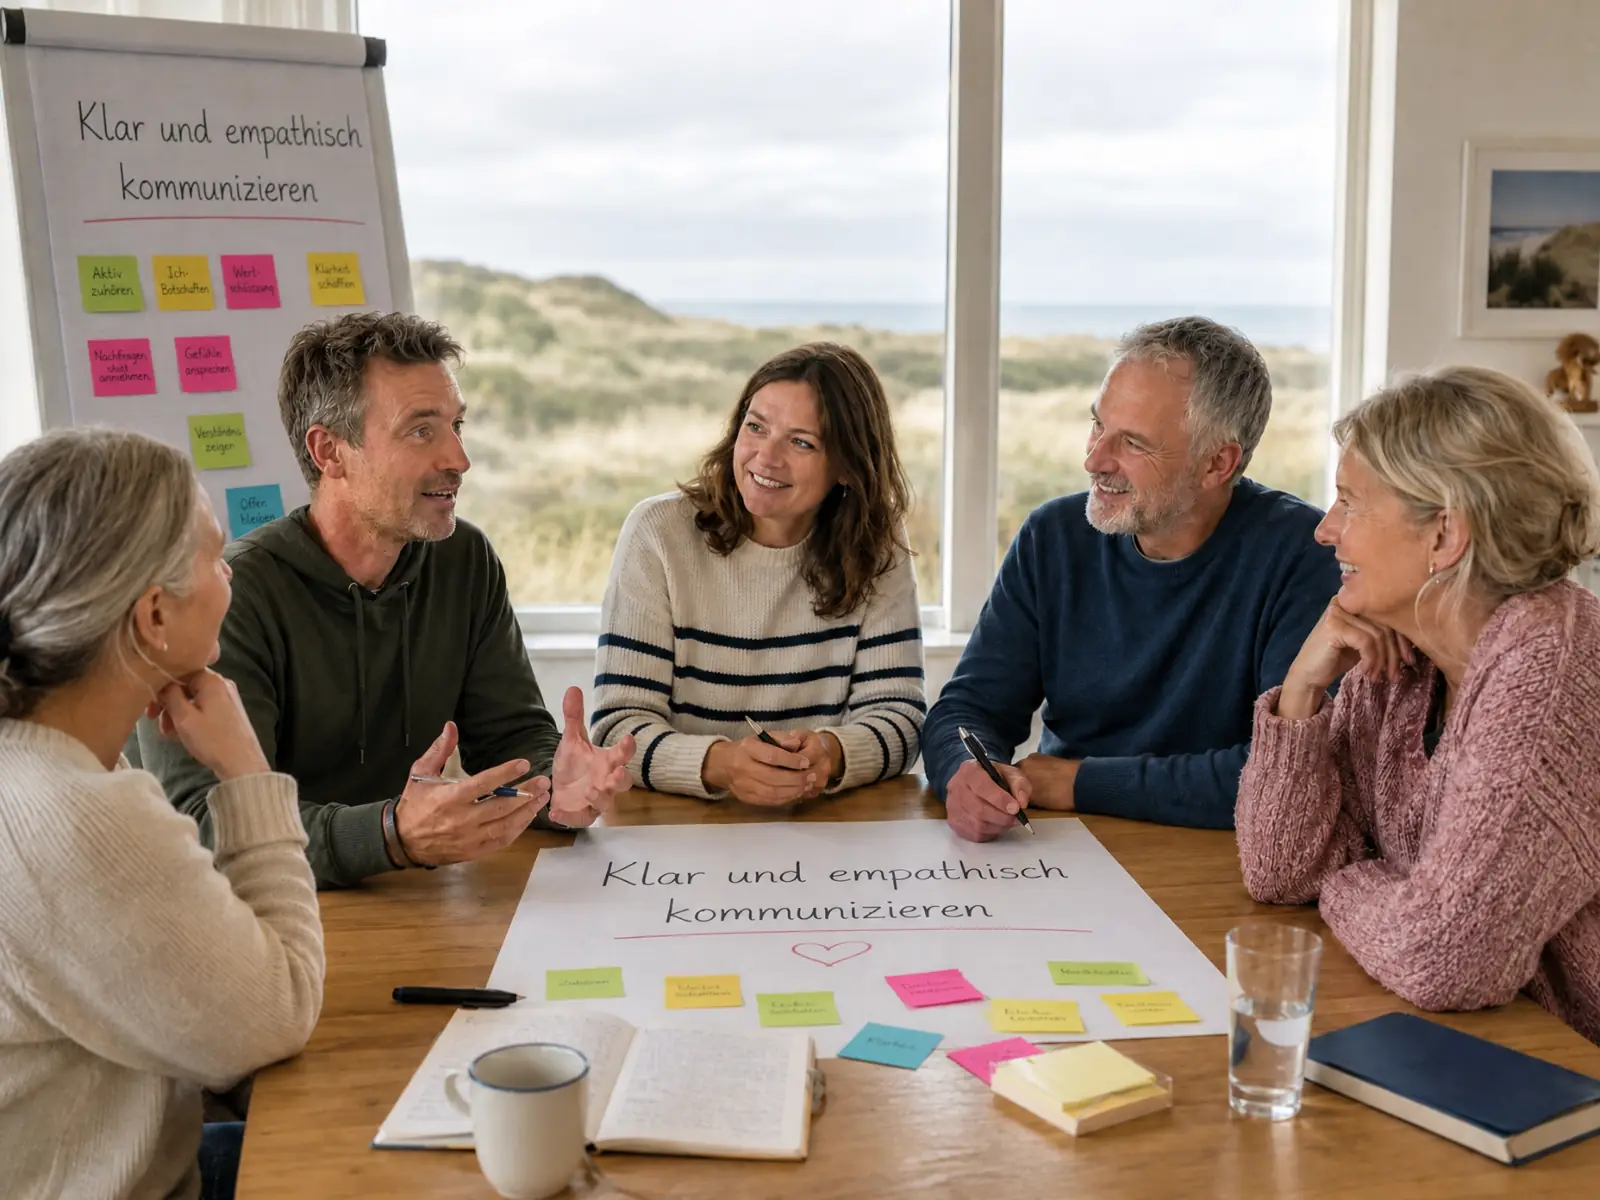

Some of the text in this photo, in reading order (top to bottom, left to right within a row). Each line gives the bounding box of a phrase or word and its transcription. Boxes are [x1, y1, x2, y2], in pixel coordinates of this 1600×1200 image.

[77, 100, 363, 159] Klar und empathisch
[119, 162, 318, 203] kommunizieren
[92, 266, 122, 280] Aktiv
[91, 284, 134, 297] zuhören
[160, 282, 210, 296] Botschaften
[94, 349, 148, 365] Nachfragen
[99, 373, 152, 383] annehmen
[184, 363, 232, 379] ansprechen
[205, 441, 235, 456] zeigen
[240, 496, 268, 511] Offen
[240, 512, 277, 526] bleiben
[602, 859, 1069, 890] Klar und empathisch
[665, 898, 993, 924] kommunizieren
